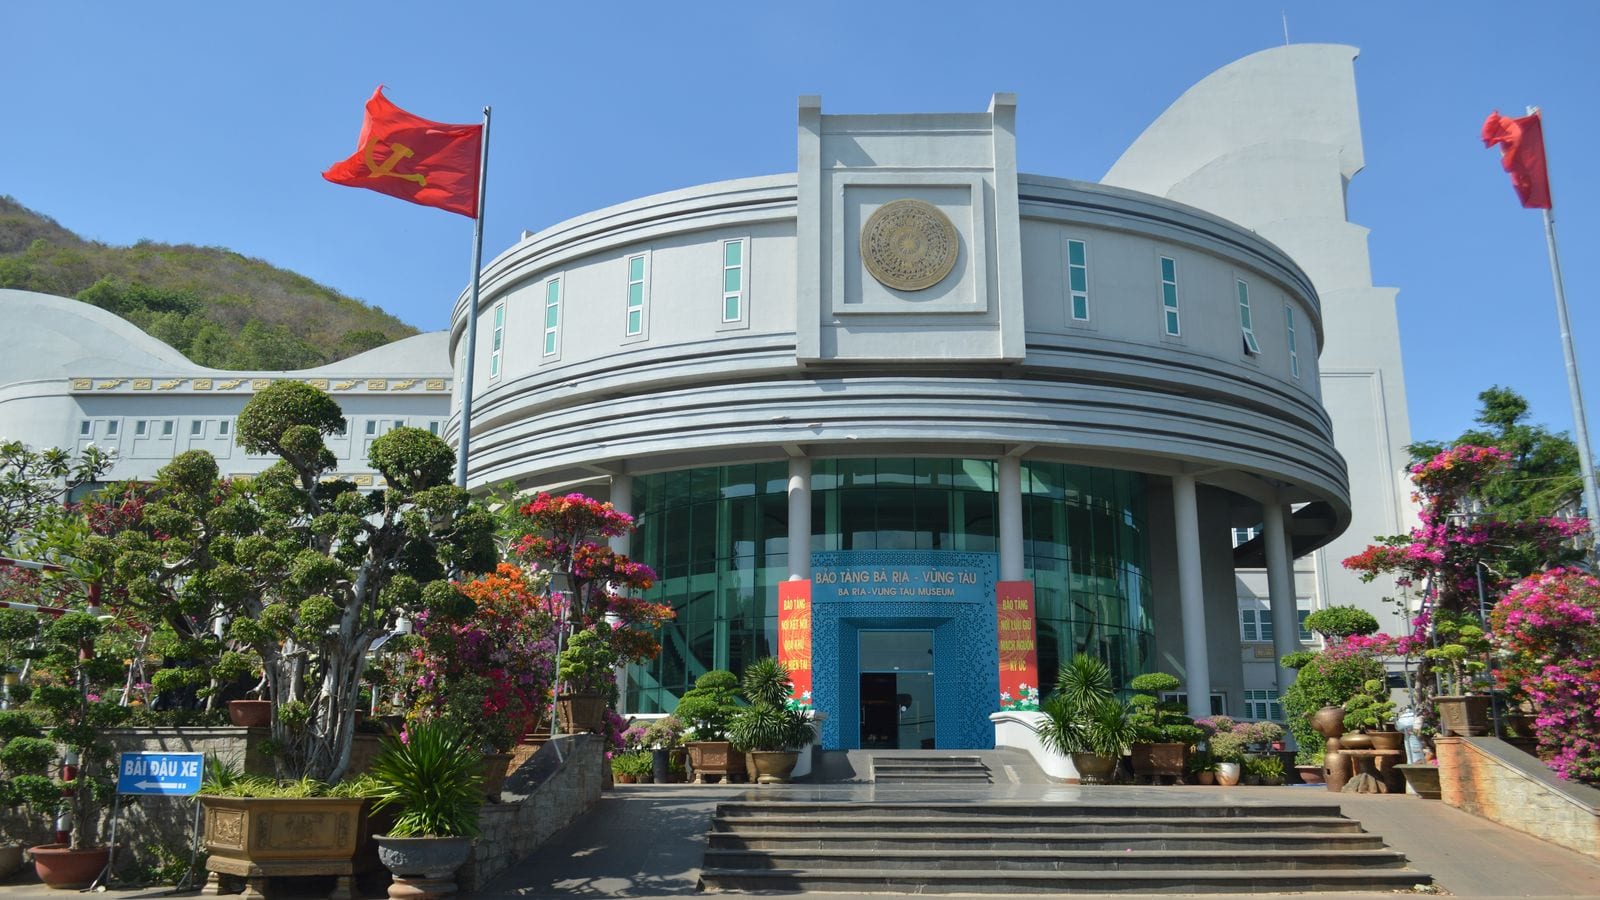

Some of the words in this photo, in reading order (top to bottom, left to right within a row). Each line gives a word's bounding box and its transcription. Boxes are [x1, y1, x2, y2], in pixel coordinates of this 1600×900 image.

[816, 567, 837, 583] BẢO
[840, 568, 869, 583] TÀNG
[874, 567, 888, 582] BÀ
[892, 570, 909, 585] RỊA
[922, 567, 955, 583] VŨNG
[958, 569, 977, 584] TÀU
[838, 587, 850, 596] BA
[900, 587, 915, 596] TAU
[918, 587, 955, 596] MUSEUM
[1002, 596, 1013, 610] BẢO
[1014, 596, 1028, 610] TÀNG
[124, 757, 147, 776] BÃI
[149, 757, 178, 781] ĐẬU
[181, 761, 199, 777] XE
